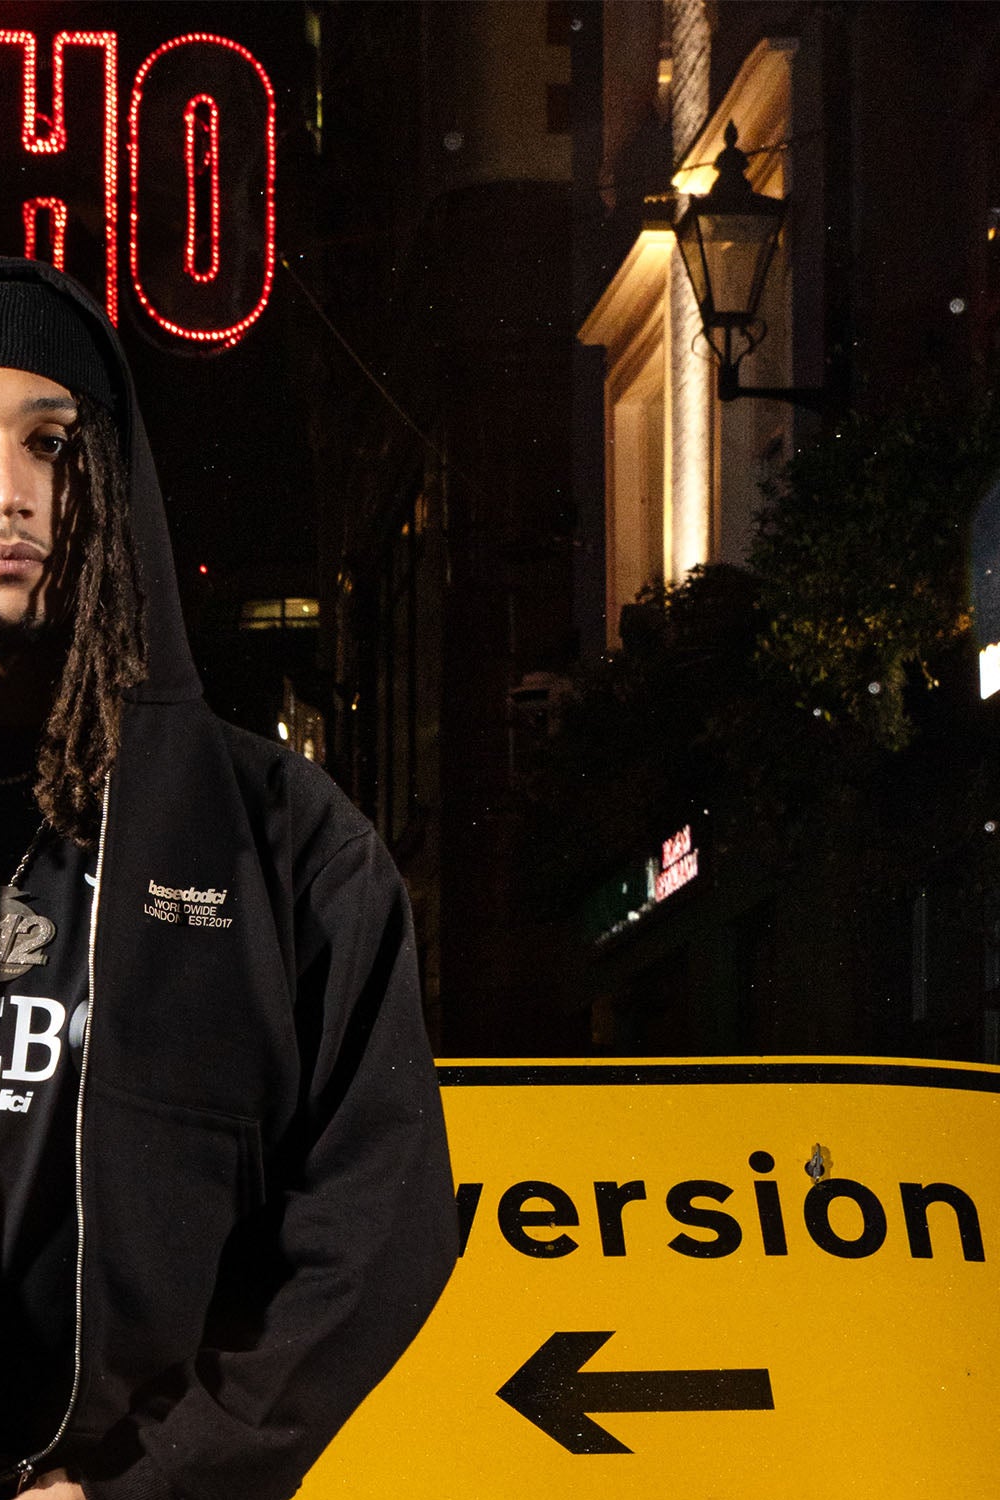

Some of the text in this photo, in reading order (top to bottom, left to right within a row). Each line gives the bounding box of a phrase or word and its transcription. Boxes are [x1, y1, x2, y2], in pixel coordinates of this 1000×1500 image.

[148, 879, 228, 904] basedodici
[154, 898, 217, 916] WORLDWIDE
[188, 915, 233, 928] EST.2017
